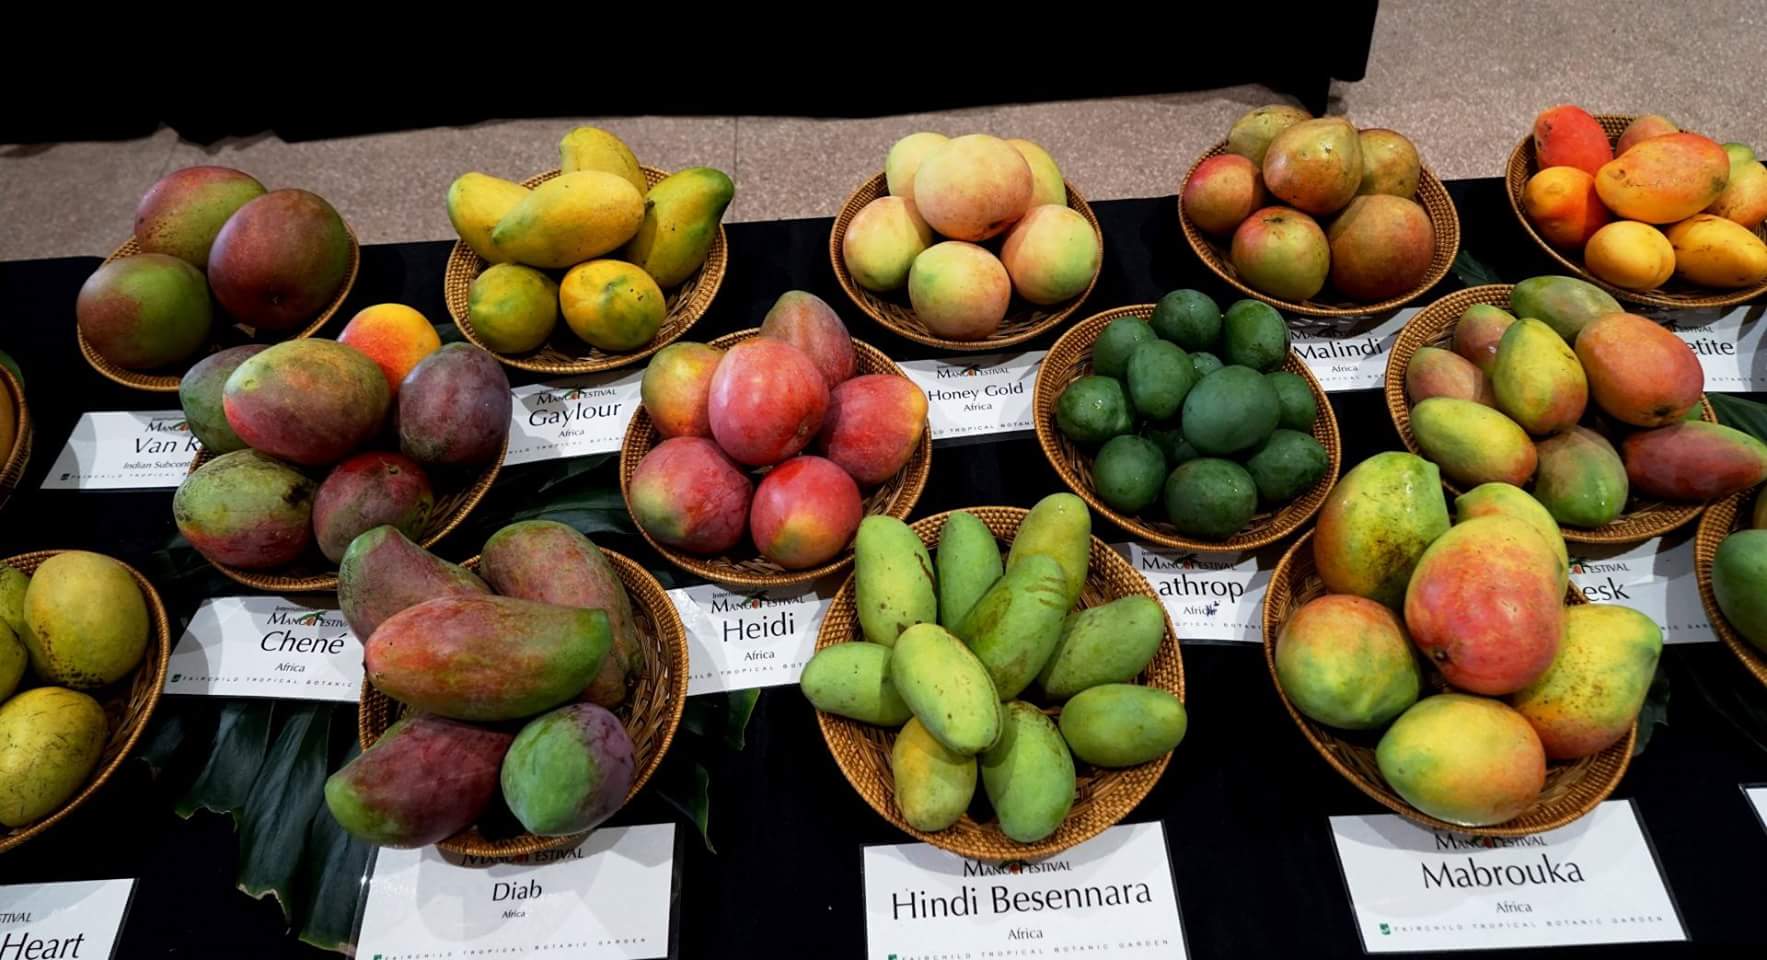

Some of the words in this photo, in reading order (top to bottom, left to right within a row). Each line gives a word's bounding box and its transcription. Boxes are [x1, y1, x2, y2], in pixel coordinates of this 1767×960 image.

[1293, 338, 1383, 360] Malindi
[1331, 365, 1359, 373] Africa
[928, 388, 979, 402] Honey
[985, 382, 1024, 397] Gold
[529, 402, 622, 427] Gaylour
[963, 403, 993, 412] Africa
[558, 429, 585, 438] Africa
[135, 438, 177, 454] Van
[1159, 574, 1244, 603] athrop
[1582, 577, 1630, 602] esk
[1184, 606, 1214, 615] Afric
[723, 612, 795, 642] Heidi
[261, 629, 347, 654] Chené
[744, 650, 775, 661] Africa
[275, 662, 306, 673] Africa
[1422, 854, 1585, 889] Mabrouka
[492, 879, 543, 902] Diab
[892, 886, 978, 920] Hindi
[991, 882, 1152, 914] Besennara
[1496, 901, 1533, 914] Africa
[502, 910, 526, 919] Africa
[1007, 927, 1044, 940] Africa
[0, 932, 85, 960] Heart
